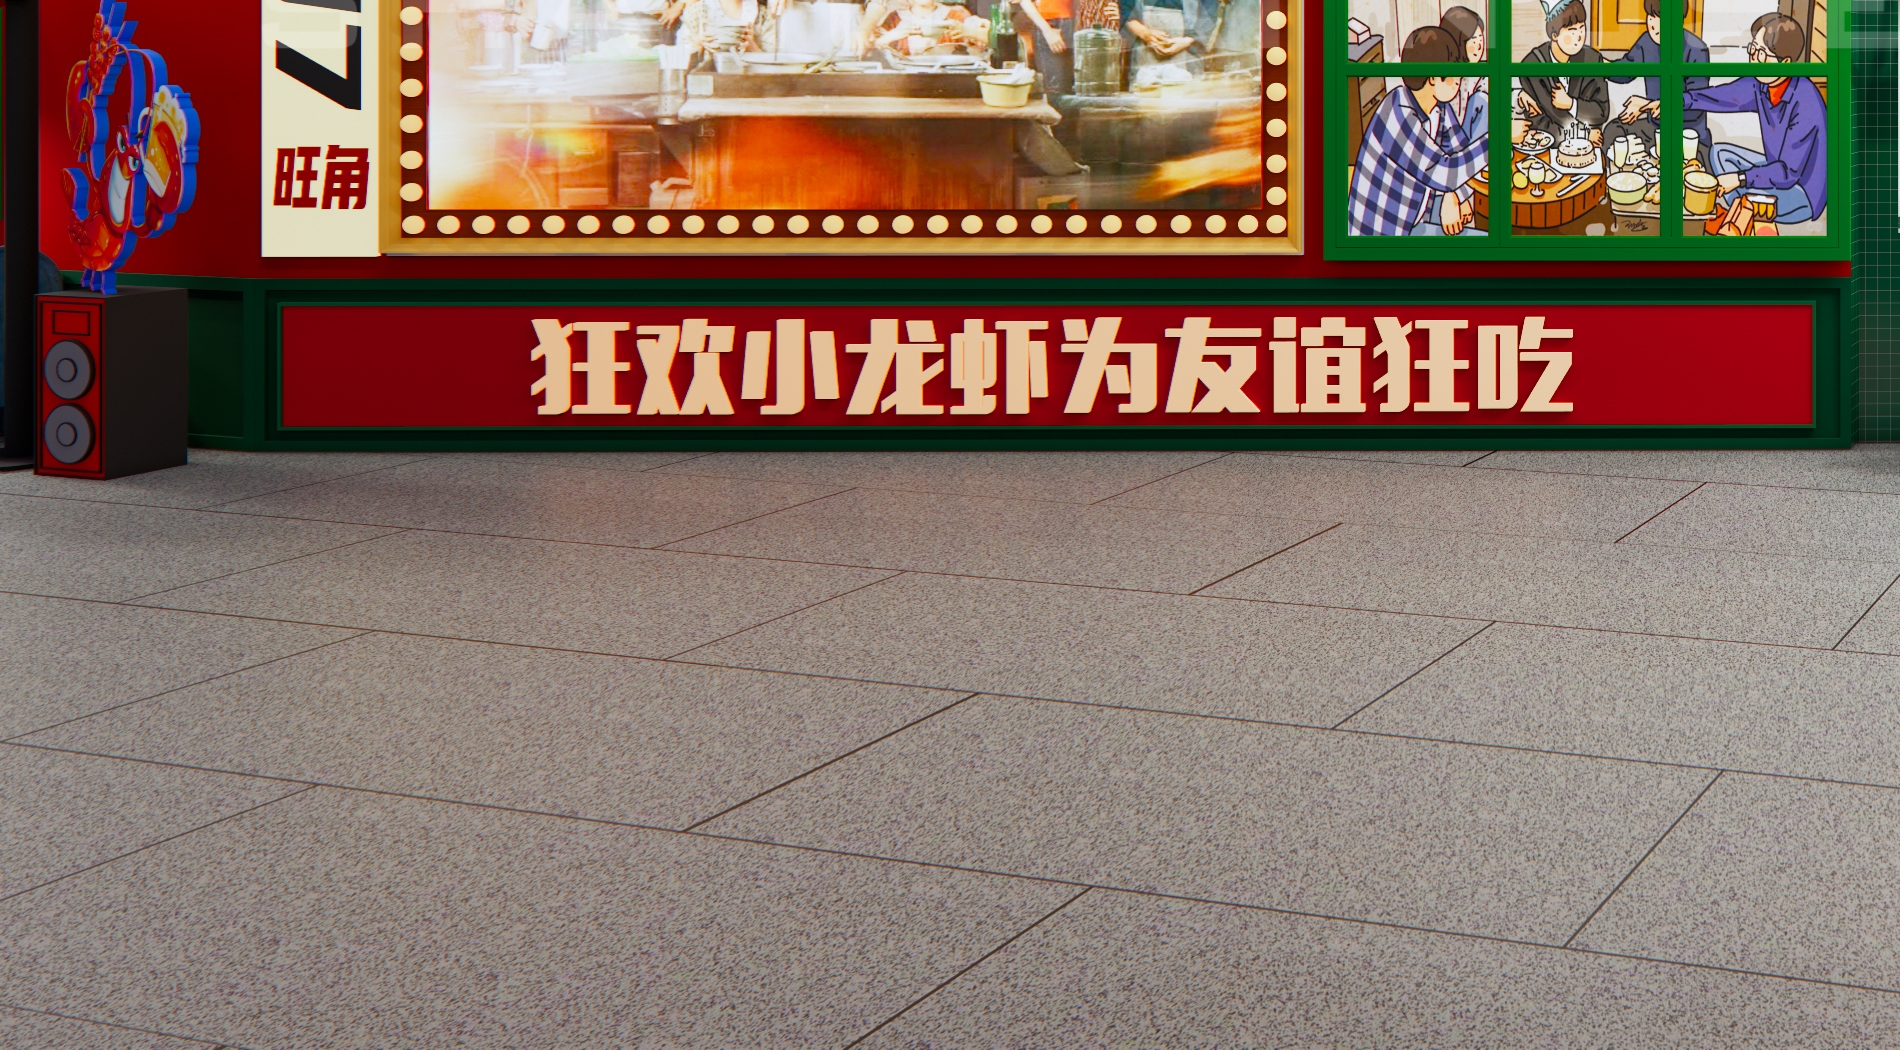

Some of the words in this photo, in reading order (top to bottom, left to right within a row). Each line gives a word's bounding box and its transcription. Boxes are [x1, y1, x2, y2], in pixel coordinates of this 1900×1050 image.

[273, 145, 369, 210] 旺角
[531, 316, 1574, 416] 狂欢小龙虾为友谊狂吃
